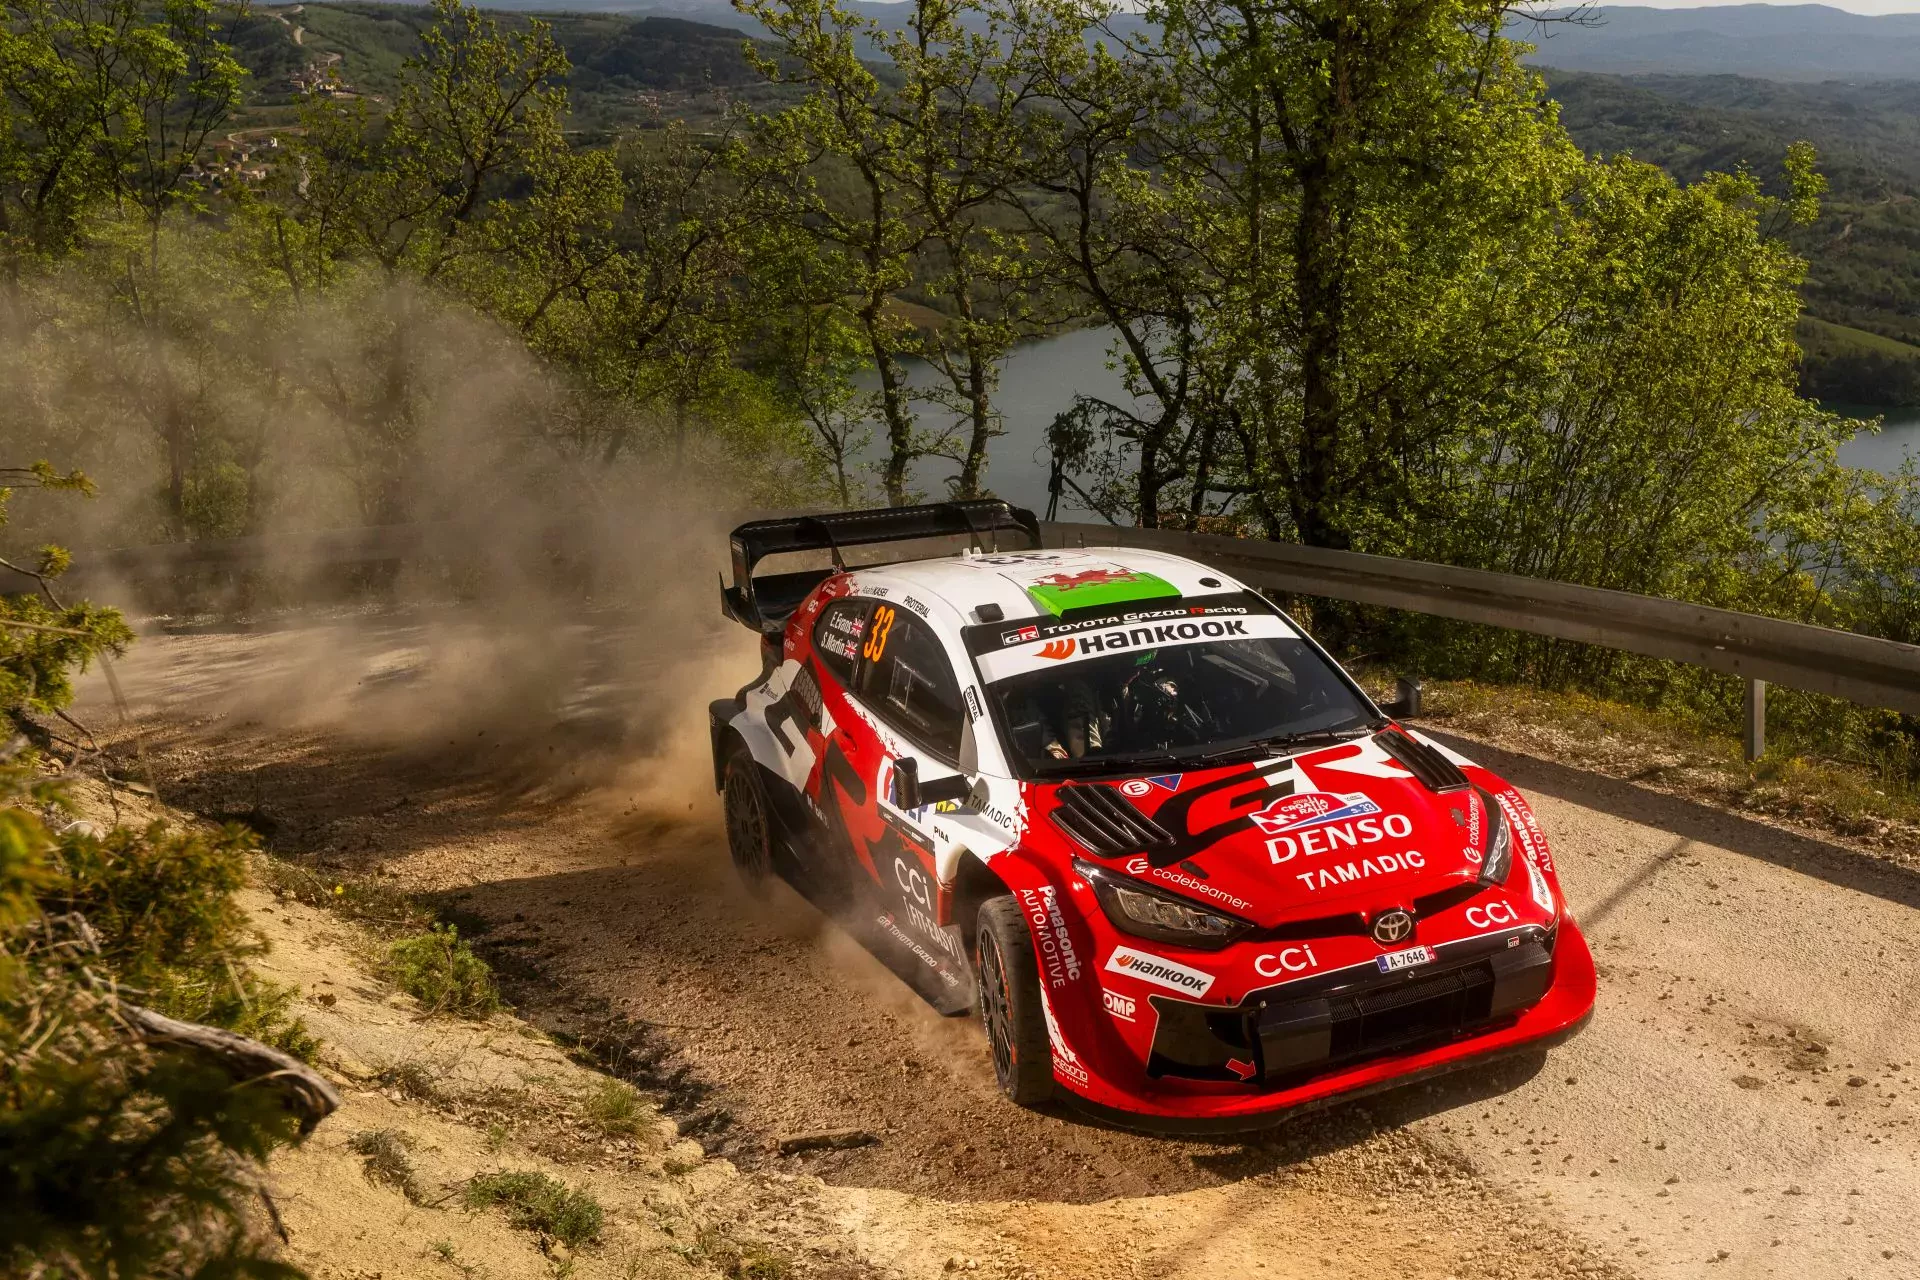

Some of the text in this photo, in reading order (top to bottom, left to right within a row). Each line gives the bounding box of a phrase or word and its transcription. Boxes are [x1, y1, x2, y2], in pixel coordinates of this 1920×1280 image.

[902, 595, 931, 618] PROTERIAL
[1043, 606, 1248, 634] TOYOTA GAZOO Racing
[863, 605, 895, 662] 33
[1003, 627, 1039, 645] GR
[971, 795, 1012, 829] TAMADIC
[1465, 794, 1479, 846] codebeamer
[1503, 789, 1553, 873] AUTOMOTIVE
[933, 826, 950, 843] PIAA
[1264, 813, 1413, 865] DENSO
[1152, 867, 1247, 910] codebeamer
[1296, 850, 1426, 891] TAMADIC
[890, 924, 914, 948] TOYOTA
[912, 943, 938, 968] GAZOO
[1020, 888, 1066, 989] AUTOMOTIVE
[1038, 885, 1081, 982] Panasonic
[1389, 949, 1426, 968] A-7646
[1103, 992, 1136, 1017] OMP
